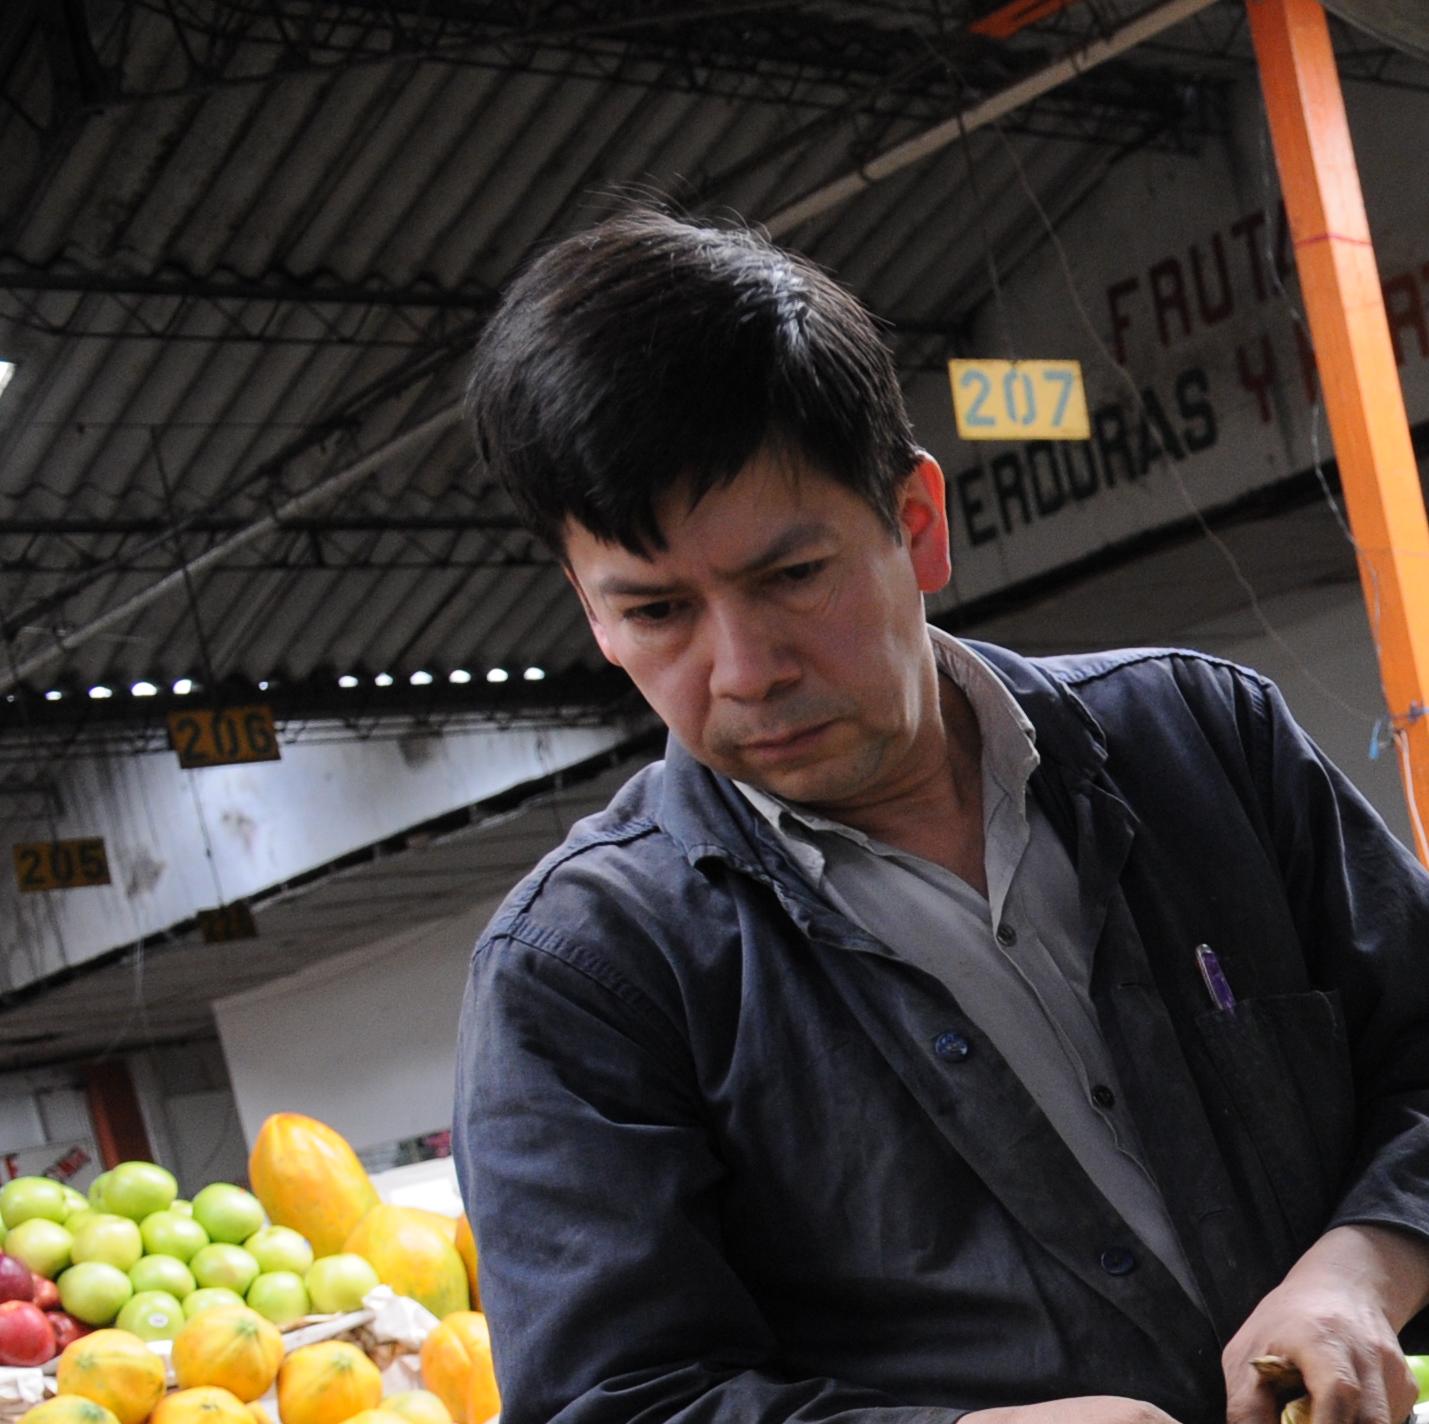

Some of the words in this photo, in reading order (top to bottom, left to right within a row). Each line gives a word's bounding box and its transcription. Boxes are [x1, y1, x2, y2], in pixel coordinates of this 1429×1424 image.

[959, 368, 1075, 427] 207
[946, 365, 1219, 547] ERDURAS
[1234, 331, 1277, 423] Y
[176, 710, 273, 763] 206
[19, 846, 106, 886] 205
